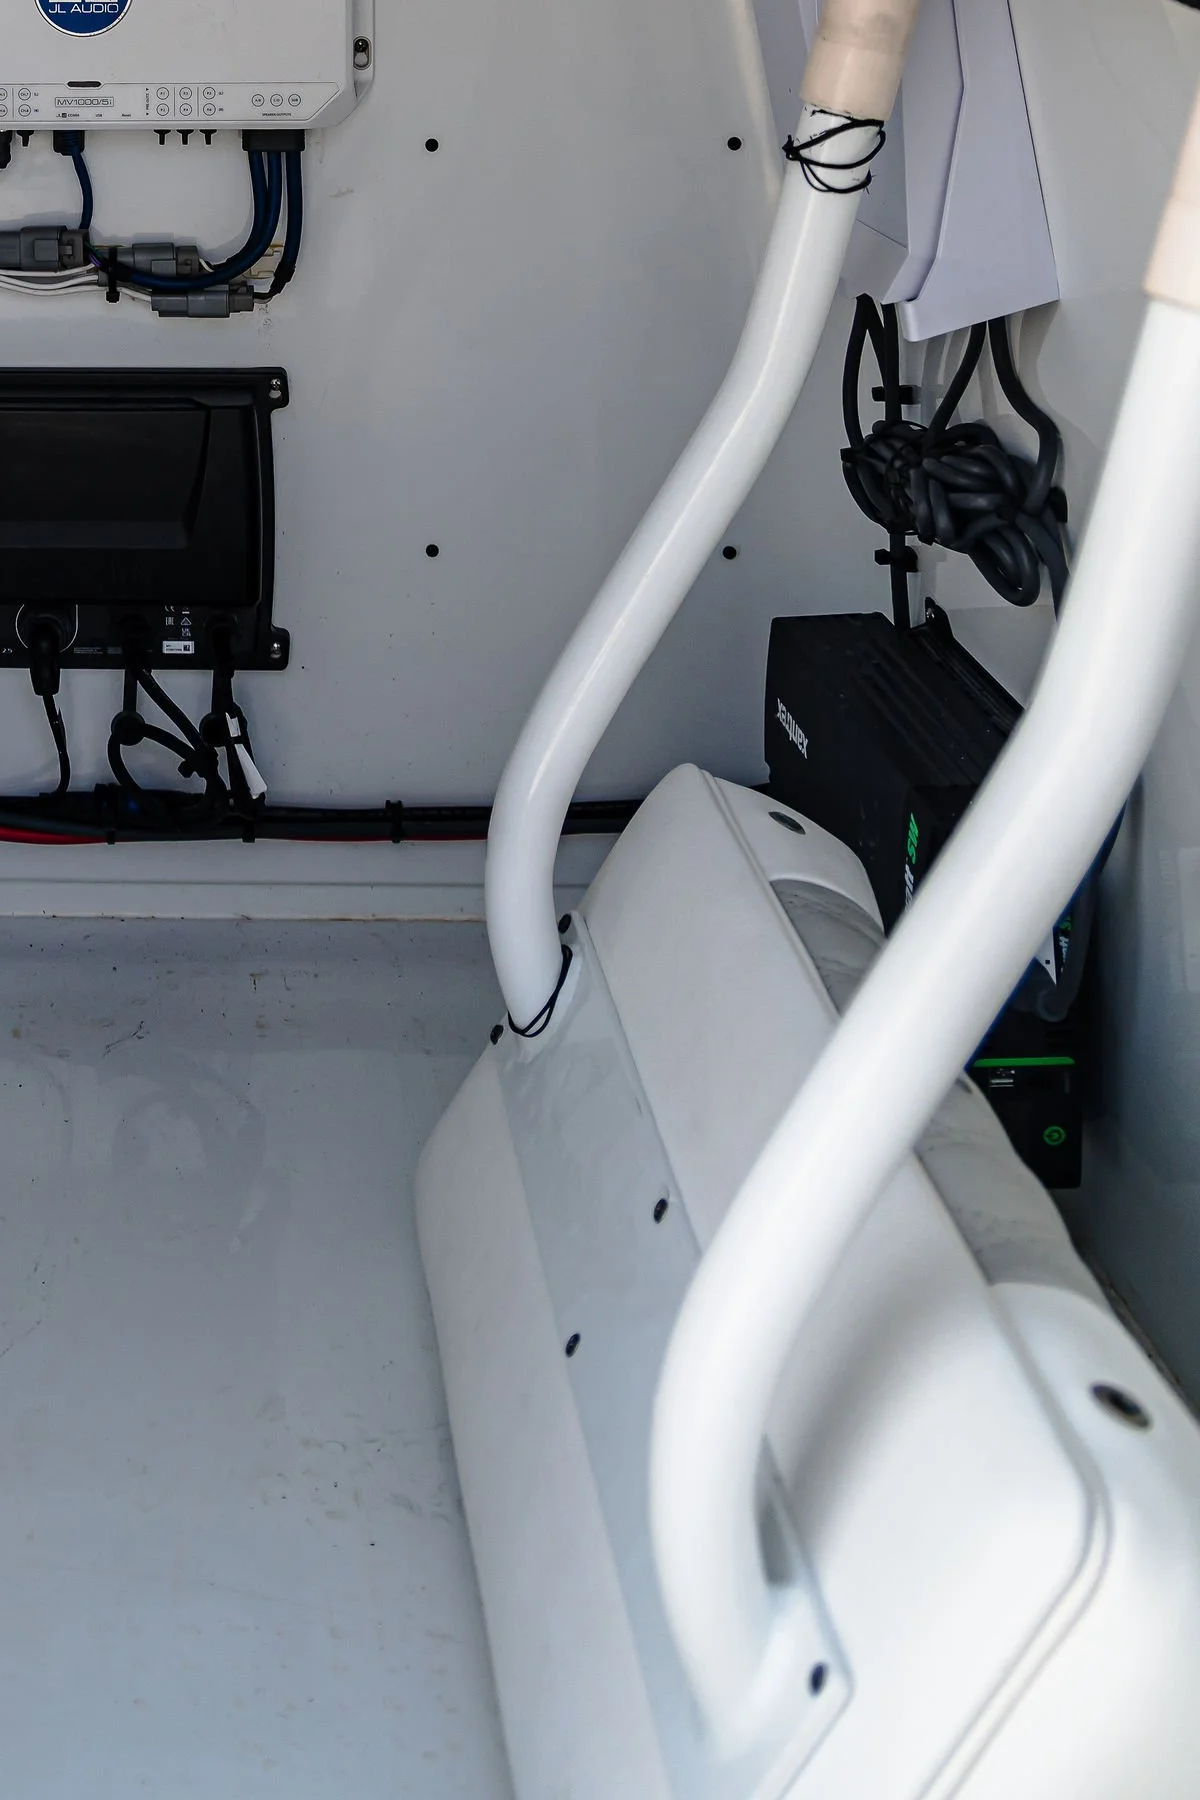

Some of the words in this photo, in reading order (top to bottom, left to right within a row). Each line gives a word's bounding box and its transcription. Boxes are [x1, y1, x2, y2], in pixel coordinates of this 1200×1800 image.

[48, 4, 66, 14] JL
[70, 4, 118, 14] AUDIO
[776, 698, 808, 759] xantrex
